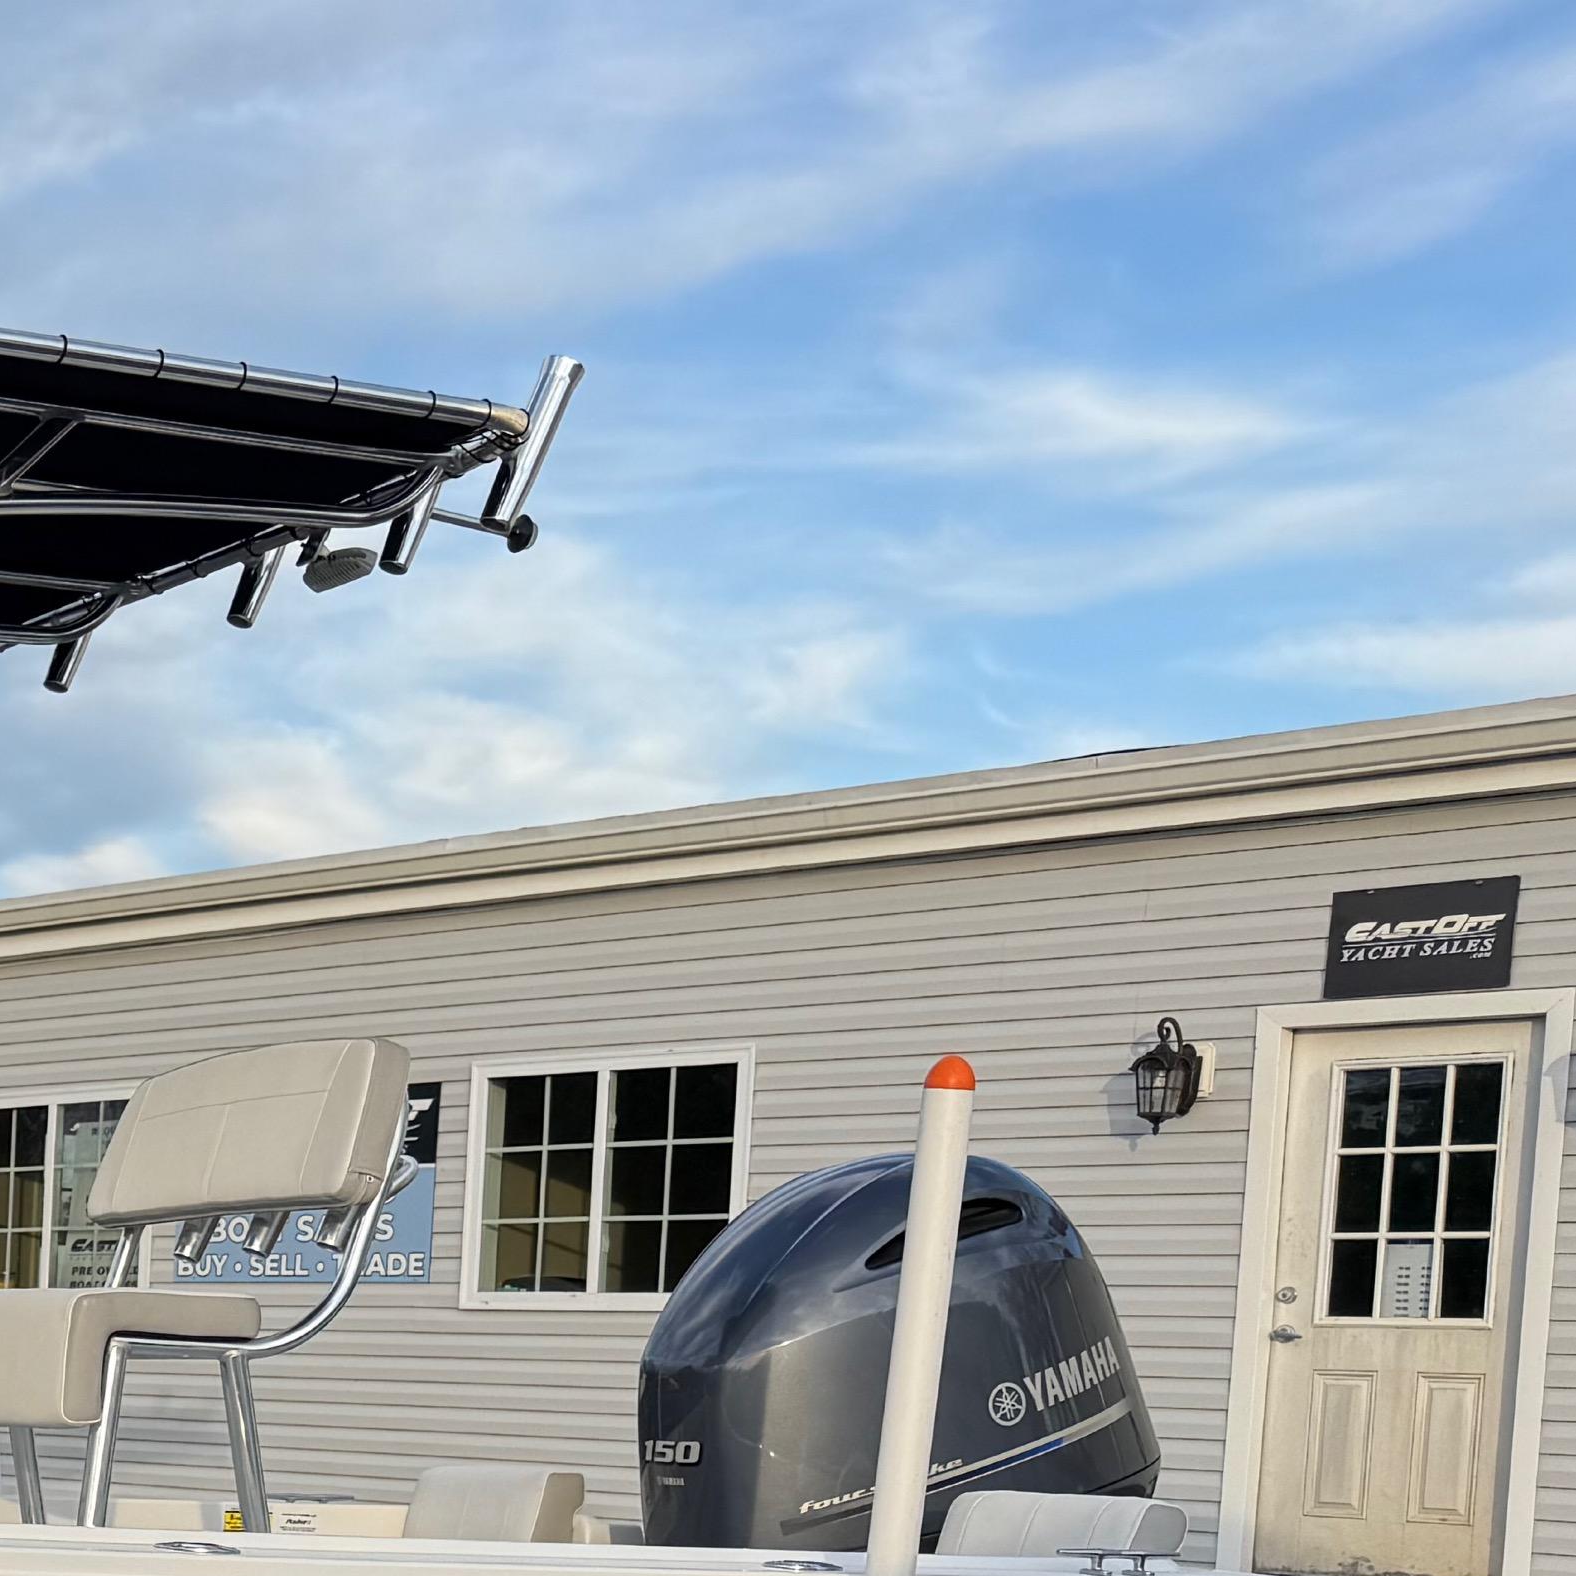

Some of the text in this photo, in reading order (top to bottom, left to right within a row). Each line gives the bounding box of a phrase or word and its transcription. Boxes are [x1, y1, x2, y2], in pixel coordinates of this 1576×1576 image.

[1340, 938, 1496, 963] YACHT SALES
[71, 1266, 93, 1276] PRE
[177, 1252, 425, 1277] BUY SELL TADE
[1023, 1335, 1120, 1412] YAMAHA
[644, 1440, 701, 1464] 150
